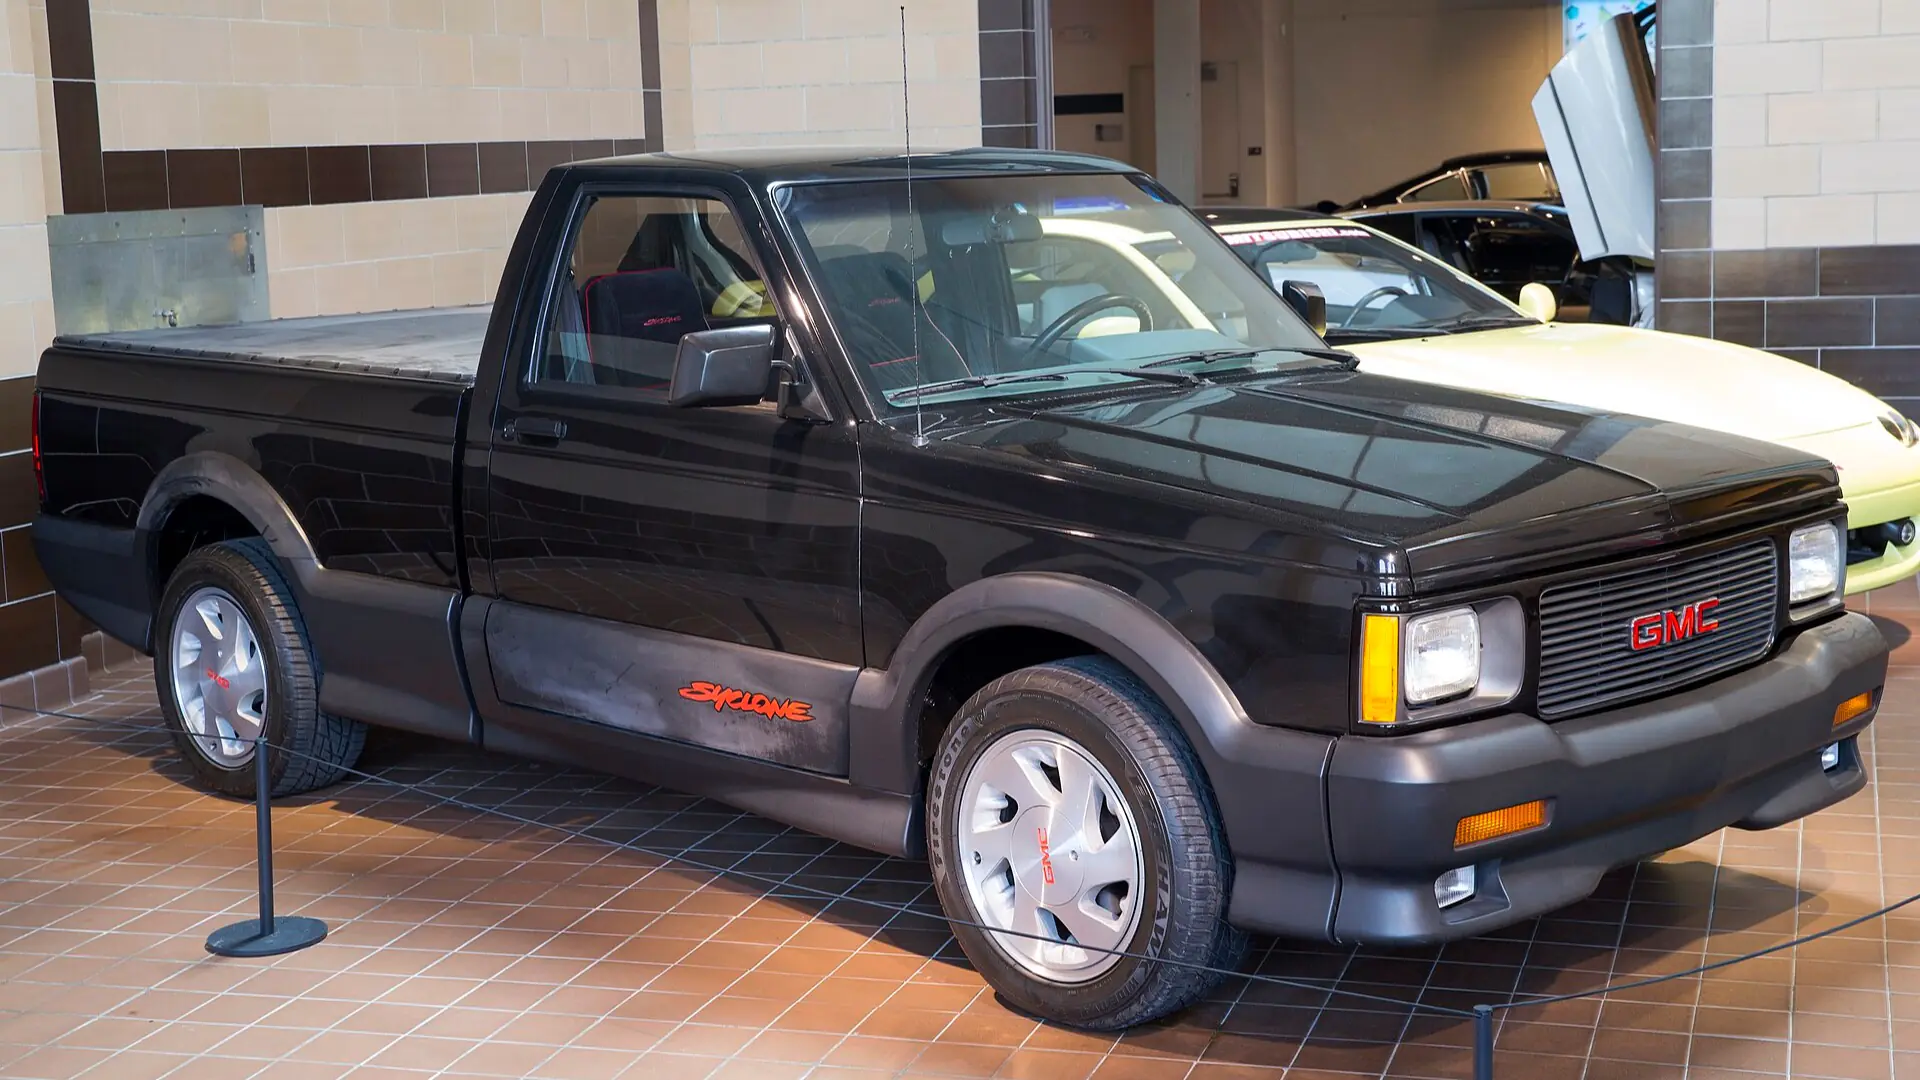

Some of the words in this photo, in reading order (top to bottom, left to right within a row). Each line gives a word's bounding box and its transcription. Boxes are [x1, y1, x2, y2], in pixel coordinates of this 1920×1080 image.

[1631, 597, 1720, 651] GMC
[677, 680, 817, 723] SYCLONE
[1037, 827, 1055, 885] GMC
